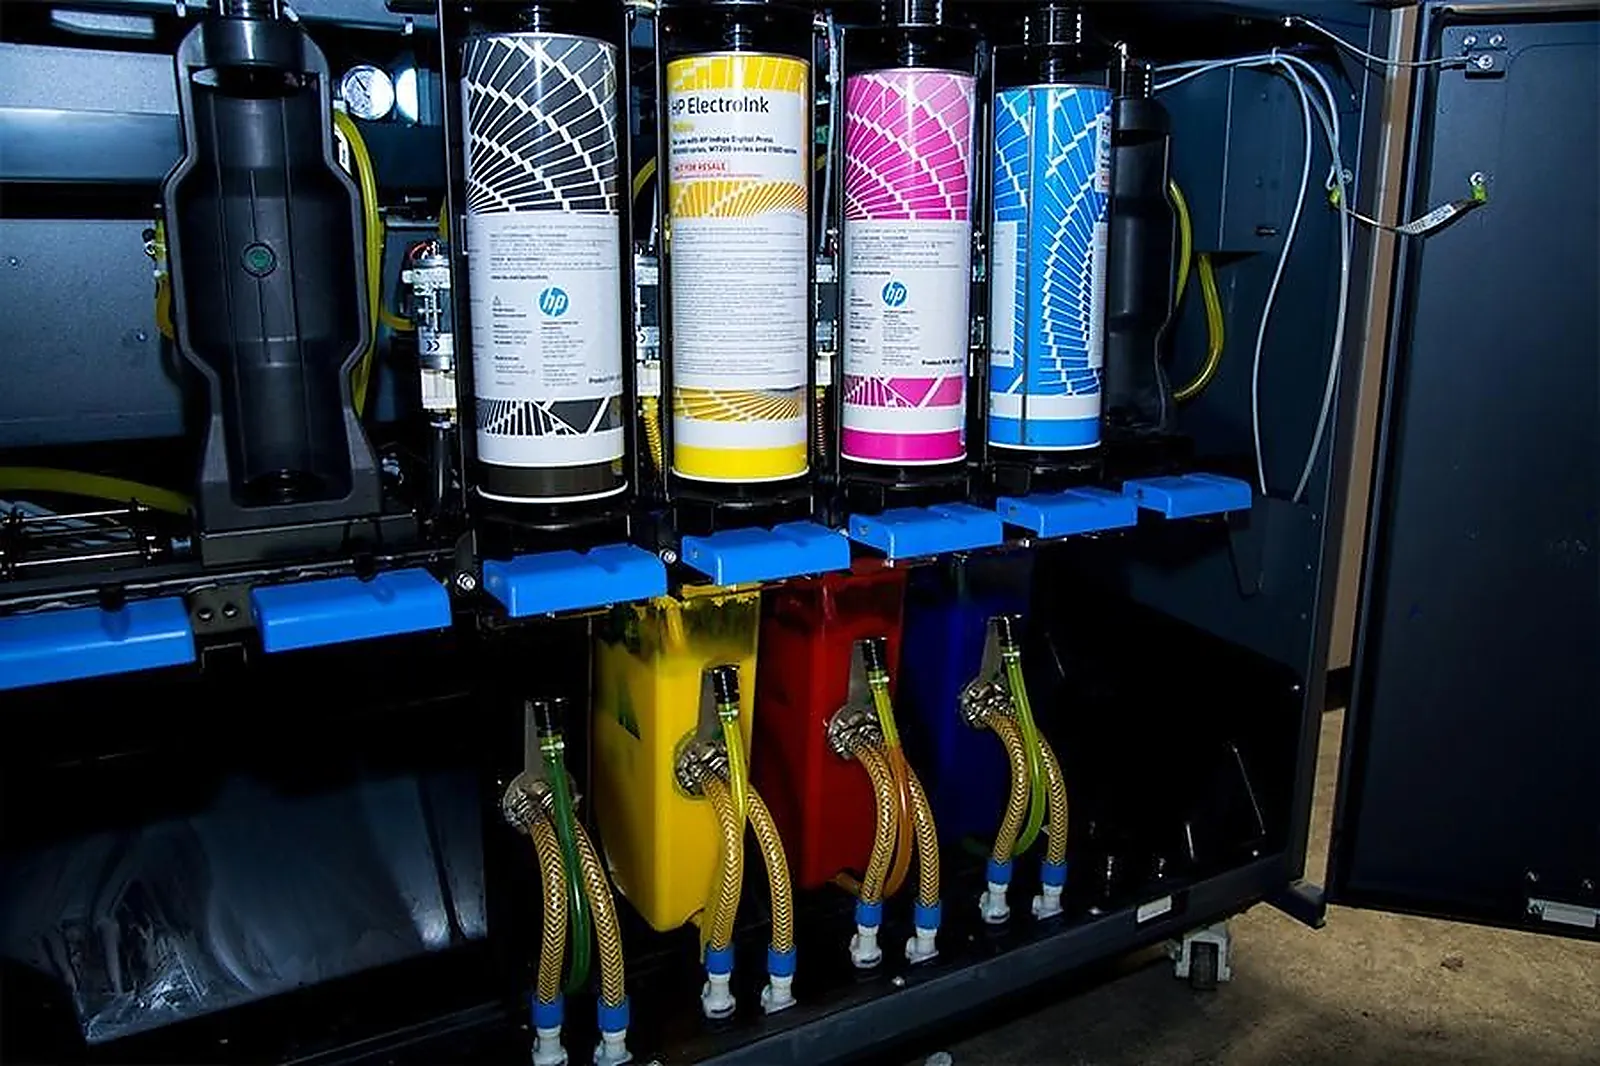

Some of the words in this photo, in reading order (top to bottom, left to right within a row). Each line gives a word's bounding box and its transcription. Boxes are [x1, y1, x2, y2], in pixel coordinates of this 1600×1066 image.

[687, 97, 769, 114] ElectroInk
[539, 287, 569, 318] hp
[882, 281, 908, 307] hp
